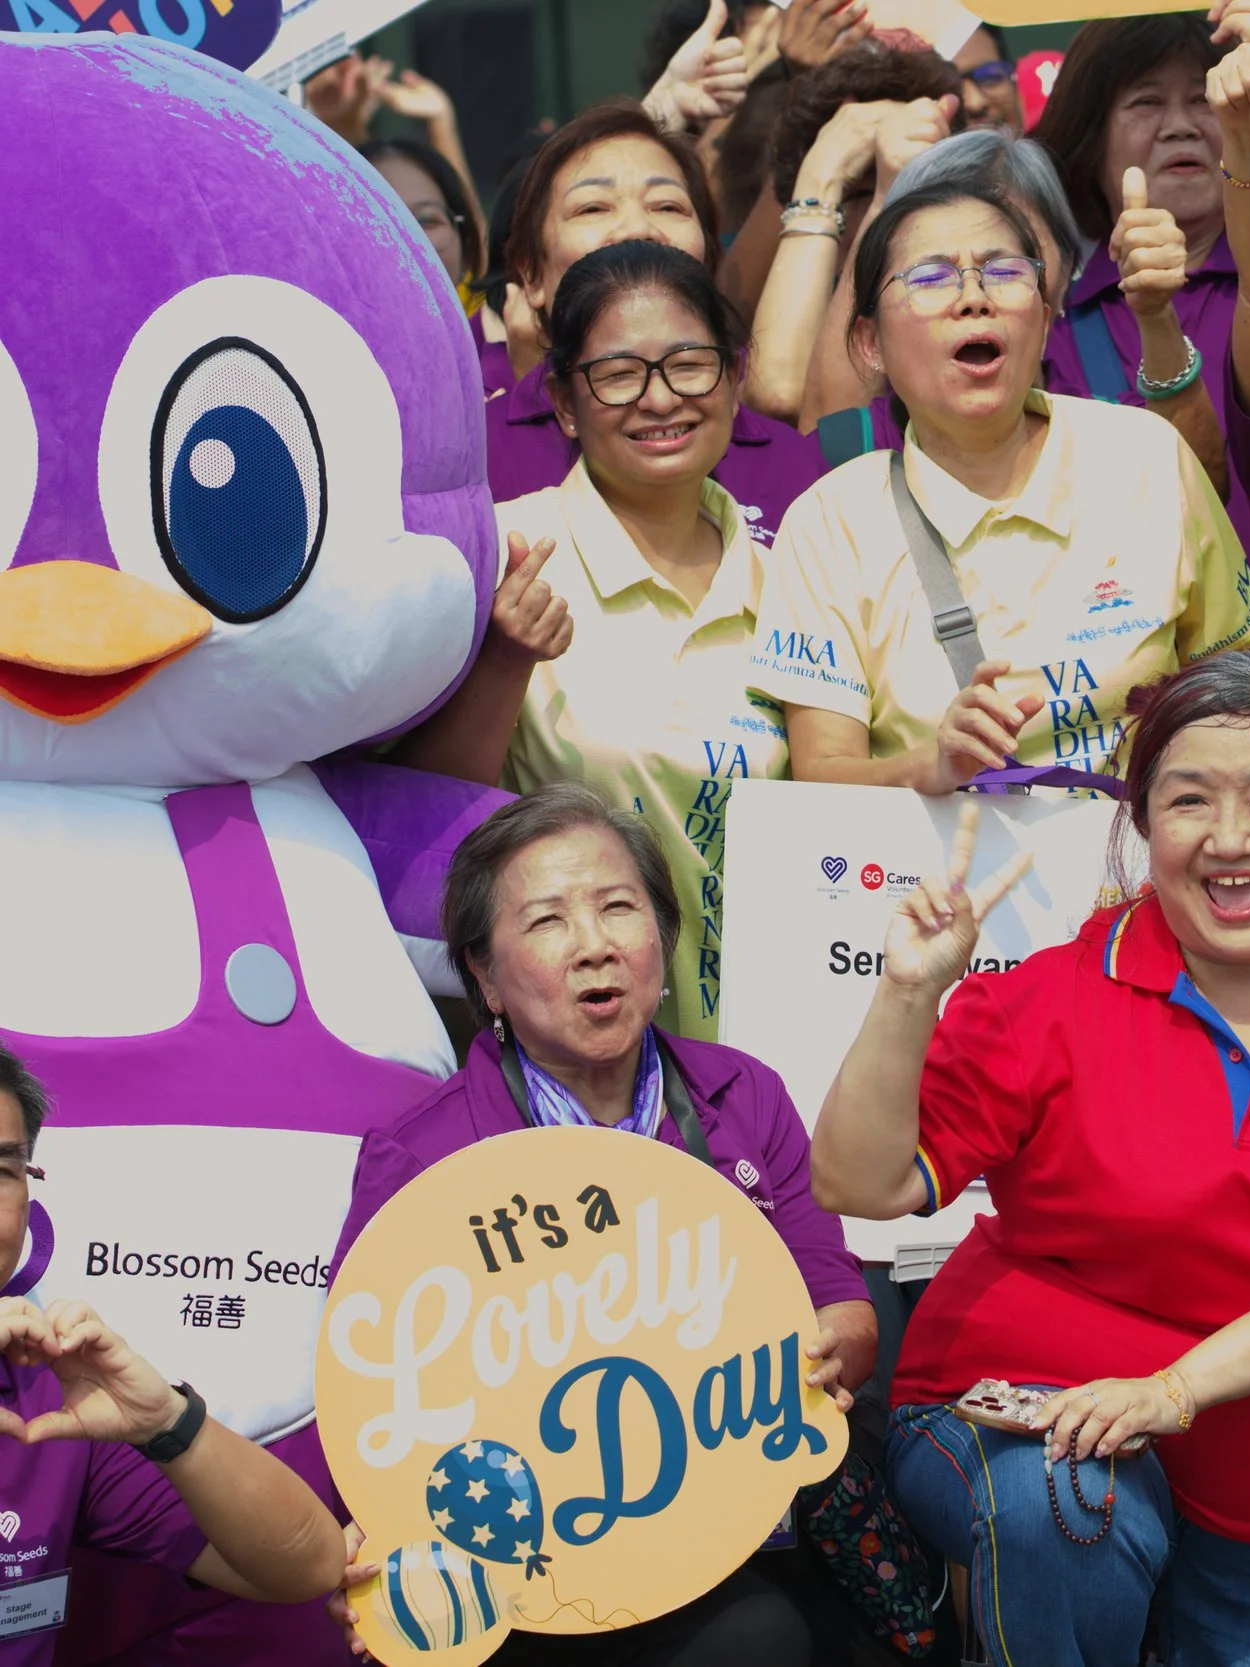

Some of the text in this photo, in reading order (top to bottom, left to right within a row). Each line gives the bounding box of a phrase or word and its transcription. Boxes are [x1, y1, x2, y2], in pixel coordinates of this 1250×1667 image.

[765, 629, 837, 668] MKA
[818, 669, 870, 697] Associati
[1040, 657, 1100, 697] VA
[1047, 694, 1100, 732] RA
[702, 740, 749, 779] VA
[864, 870, 921, 886] SG Cares
[752, 1196, 775, 1210] Seed
[468, 1184, 620, 1273] it's a
[86, 1241, 331, 1288] Blossom Seeds
[179, 1293, 246, 1330] 福善
[328, 1197, 738, 1469] Lovely
[539, 1332, 828, 1546] Day
[17, 1545, 49, 1562] Seeds
[0, 1608, 48, 1625] nagement
